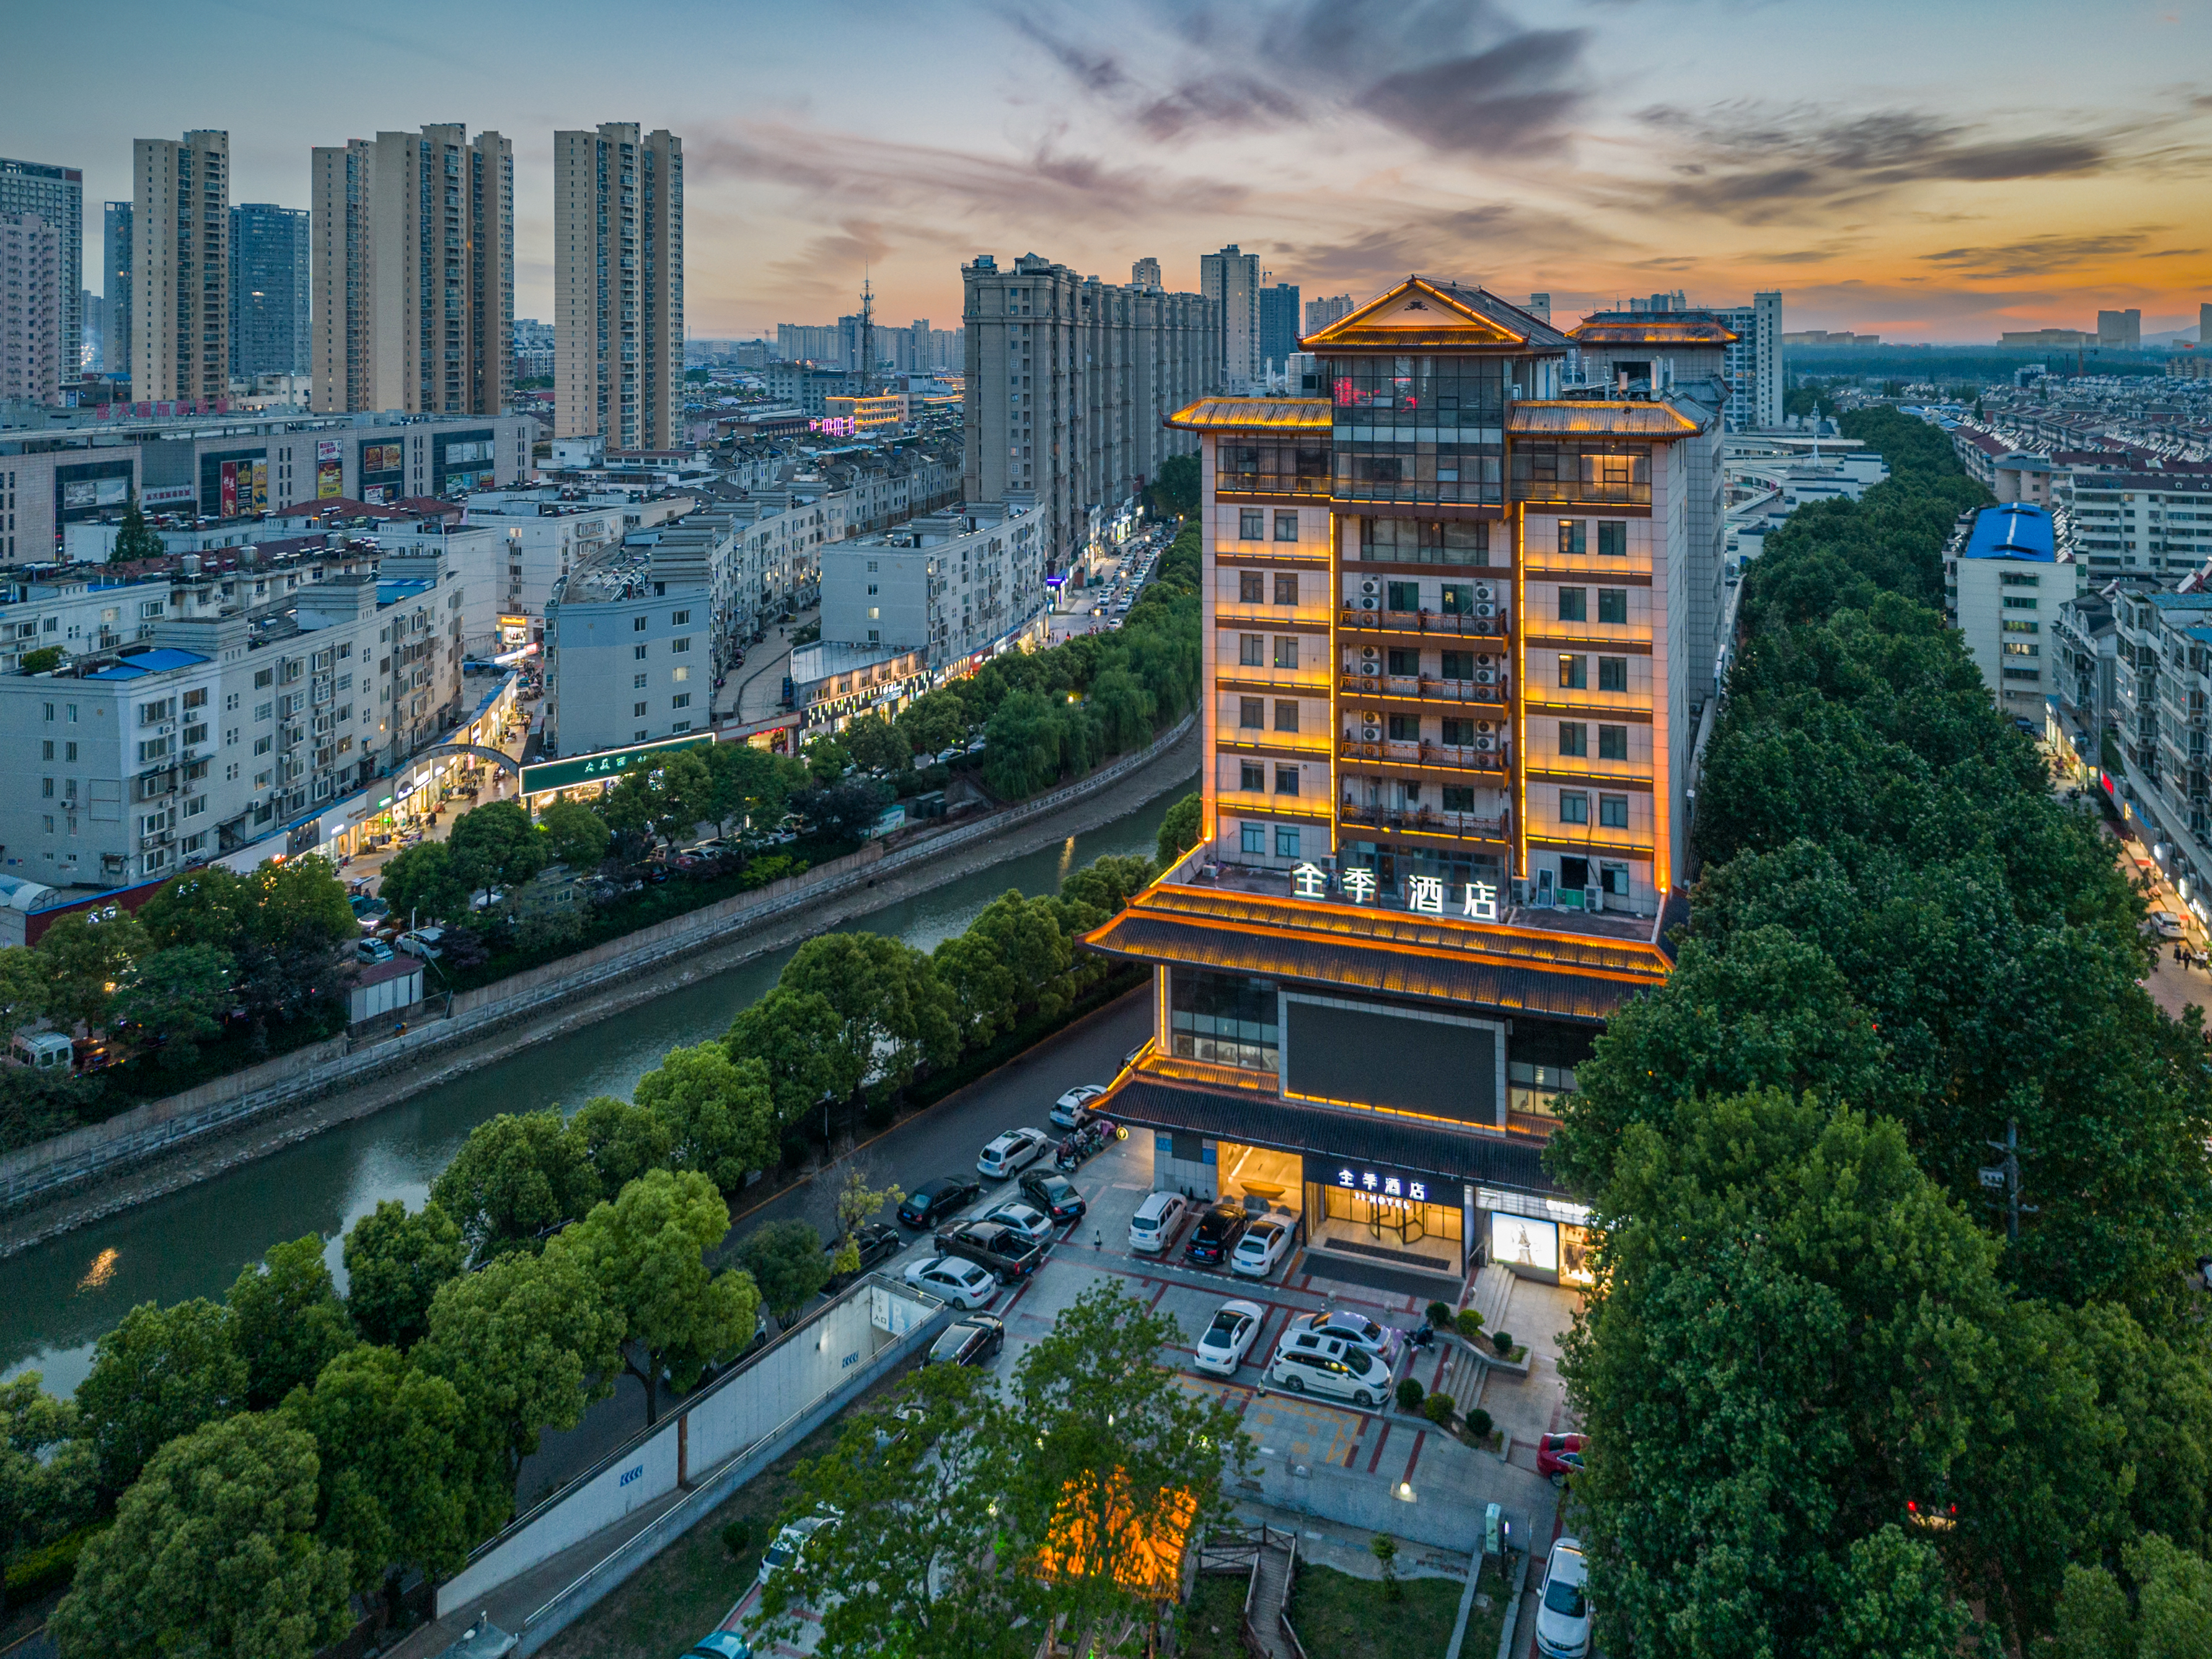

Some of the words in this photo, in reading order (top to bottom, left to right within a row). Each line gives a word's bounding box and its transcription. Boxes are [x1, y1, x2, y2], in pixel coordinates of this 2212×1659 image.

[1292, 862, 1497, 920] 全季酒店
[1338, 1169, 1425, 1201] 全季酒店
[1369, 1194, 1411, 1210] HOTEL
[874, 1314, 887, 1325] 入口
